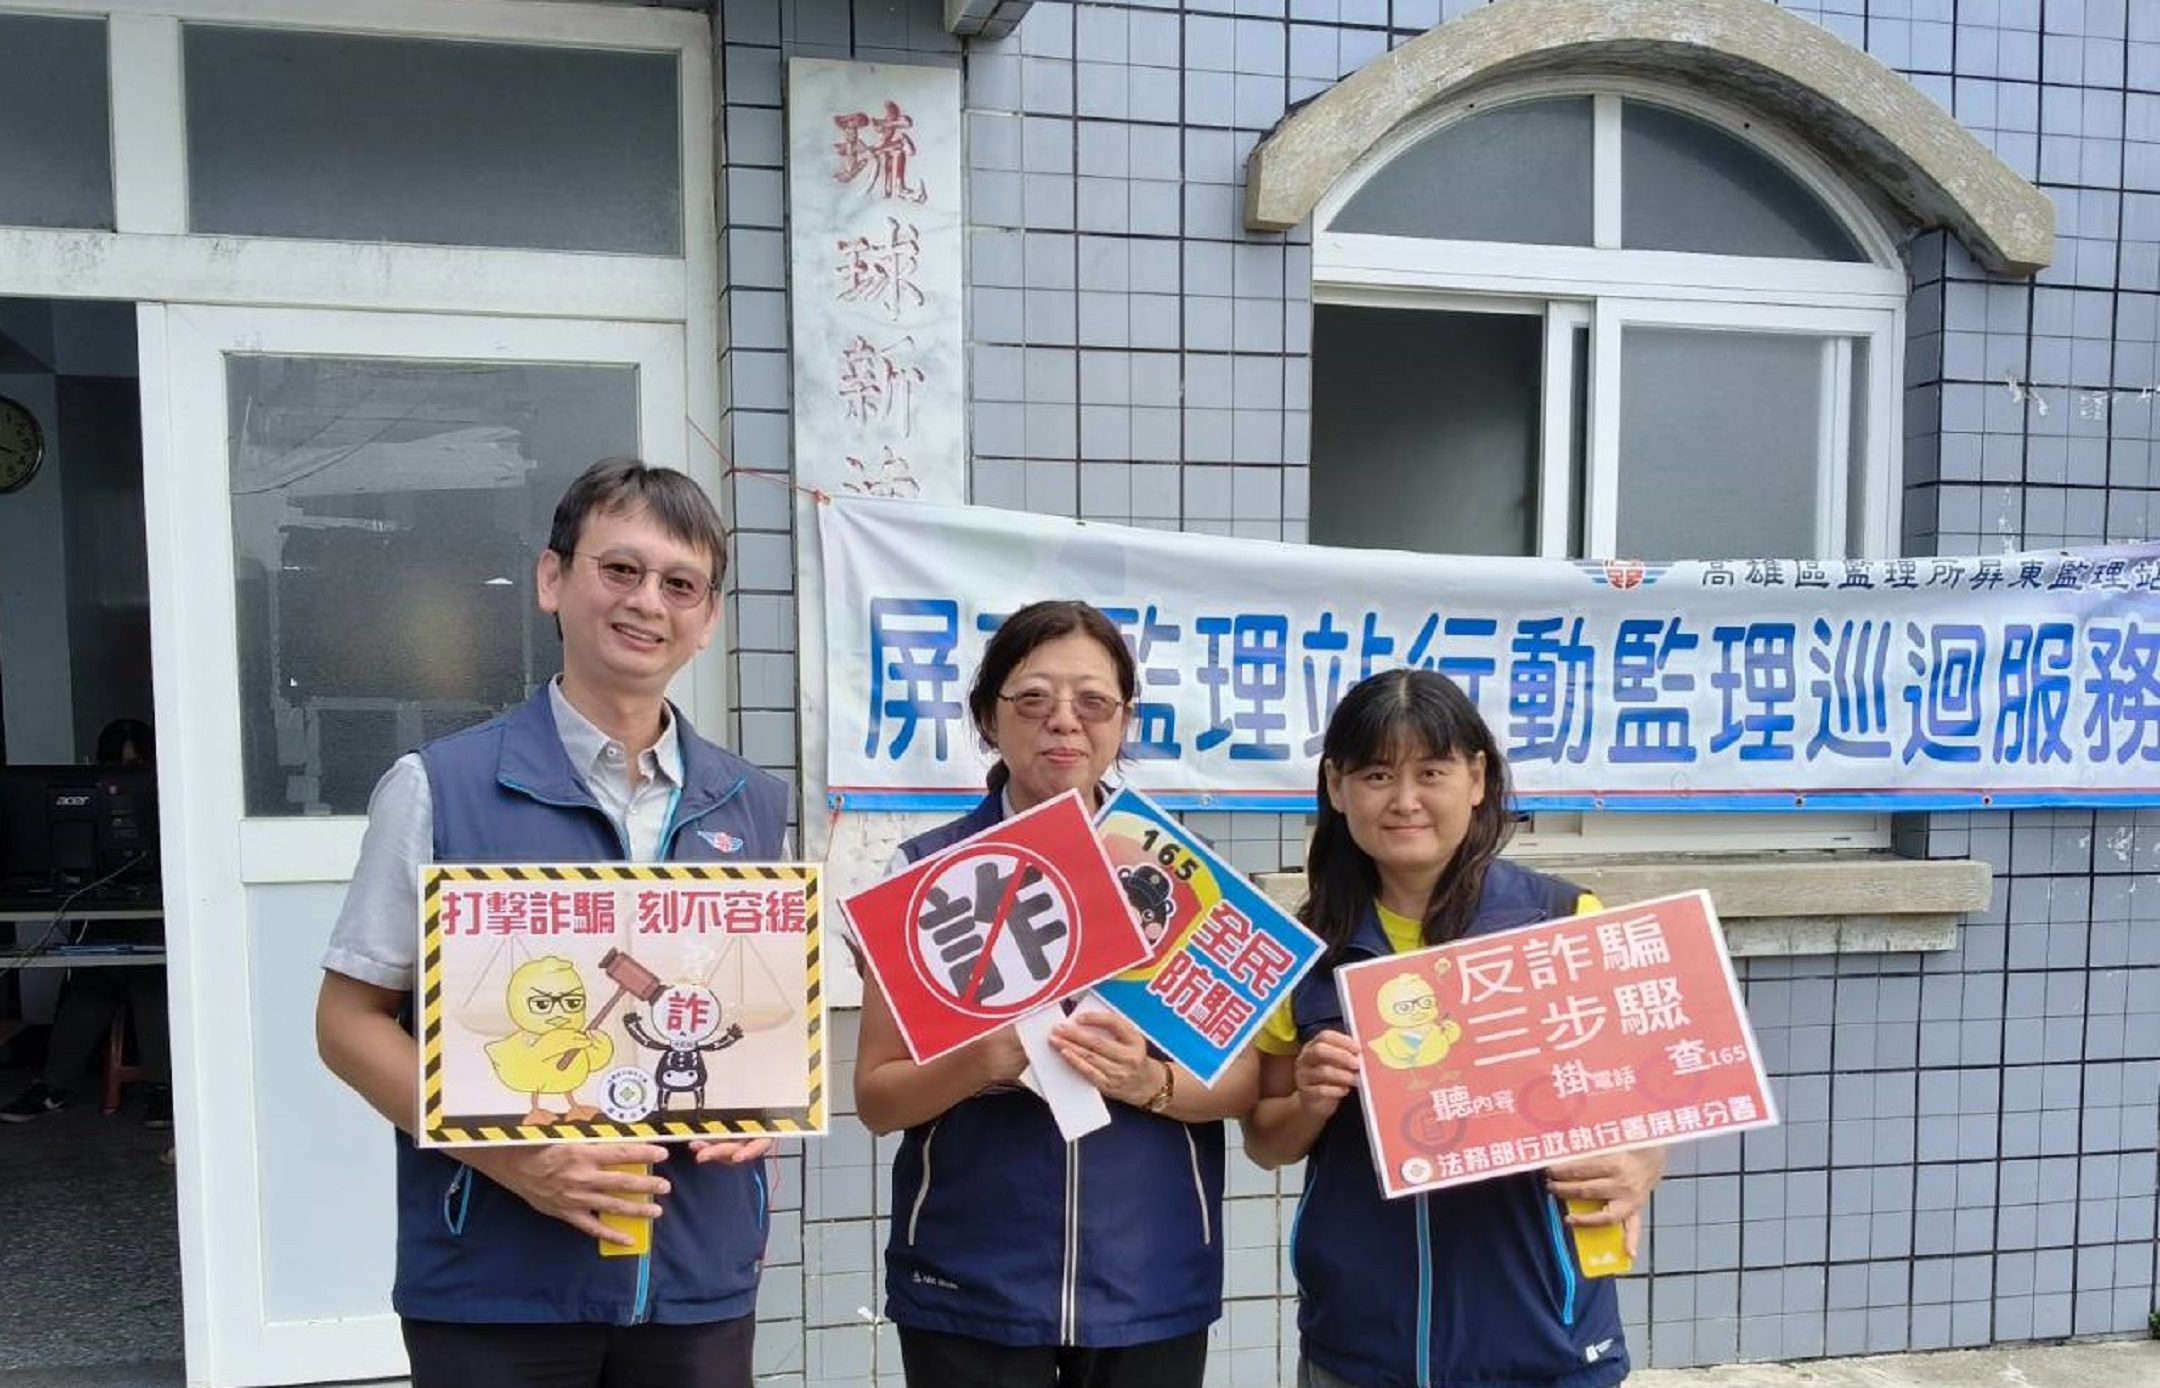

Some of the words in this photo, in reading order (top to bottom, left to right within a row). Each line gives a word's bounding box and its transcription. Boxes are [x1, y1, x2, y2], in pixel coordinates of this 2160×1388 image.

[1141, 829, 1199, 881] 165
[441, 890, 616, 936] 打擊詐騙
[638, 889, 808, 935] 刻不容緩
[918, 861, 1067, 1003] 詐
[1189, 899, 1295, 999] 全民
[1147, 950, 1257, 1050] 防騙
[1455, 913, 1672, 1006] 反詐騙
[667, 991, 710, 1034] 詐
[1467, 976, 1692, 1067] 三步驟
[1437, 1094, 1758, 1178] 法務部行政執行署屏東分署
